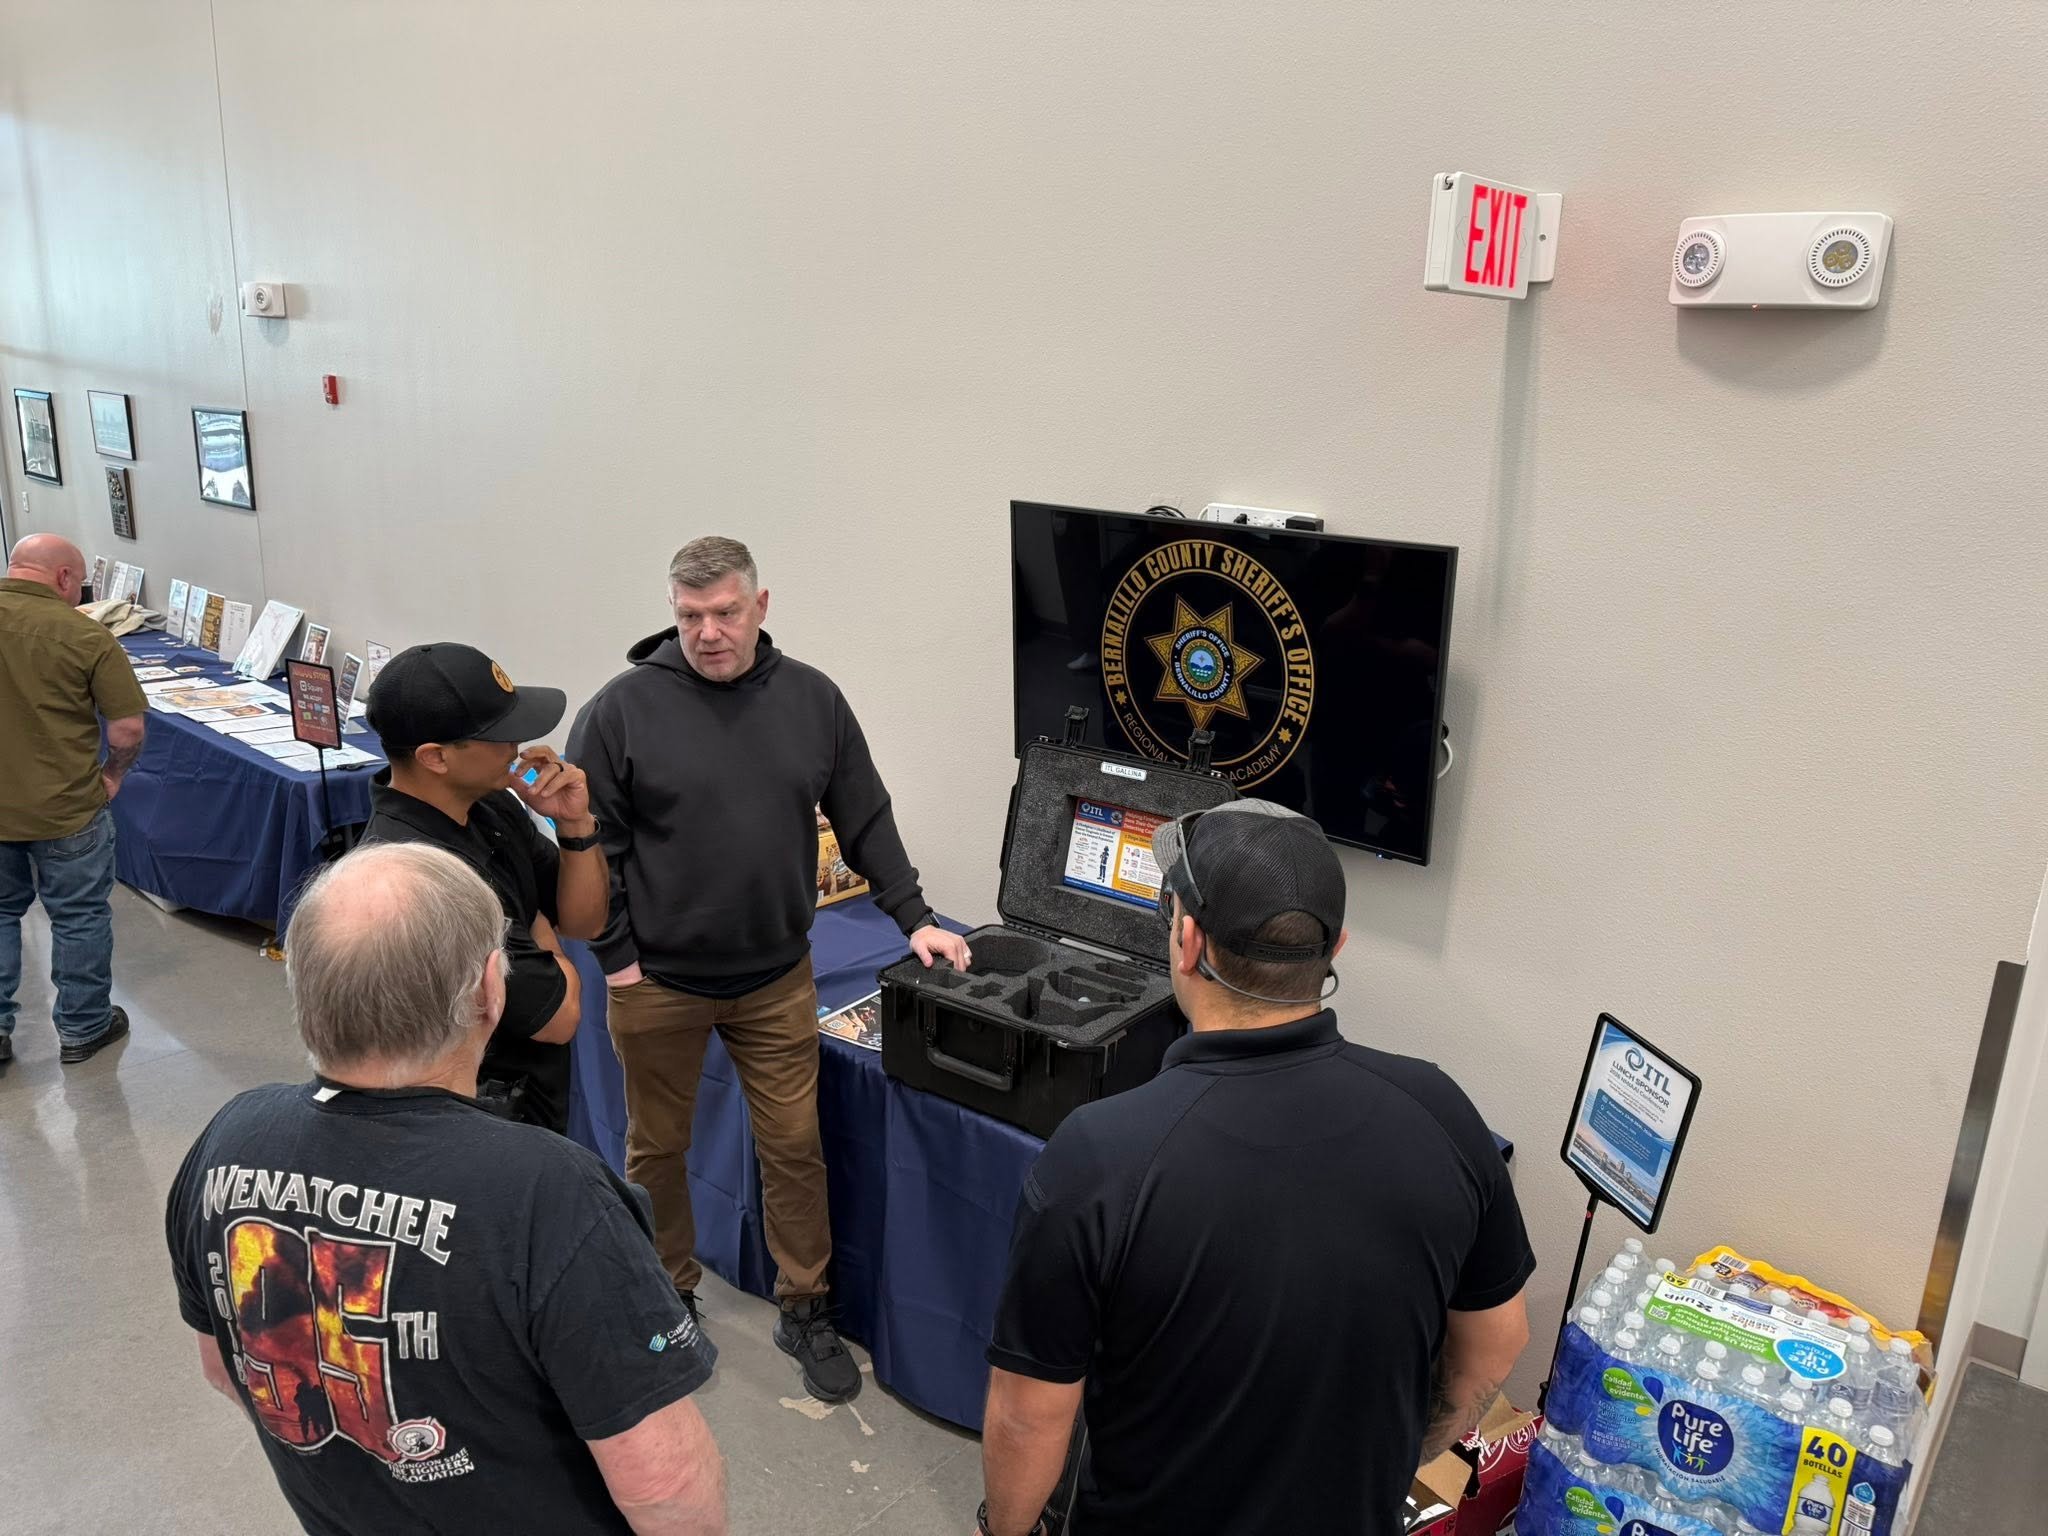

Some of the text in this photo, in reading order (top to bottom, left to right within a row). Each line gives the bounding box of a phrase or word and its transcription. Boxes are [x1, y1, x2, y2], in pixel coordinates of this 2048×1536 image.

[1464, 184, 1528, 289] EXIT
[1104, 543, 1312, 727] BERNALILLO COUNTY SHERIFF'S OFFICE
[1175, 629, 1230, 658] SHERIFF'S OFFICE
[1174, 661, 1231, 700] BERNALILLO COUNTY
[1123, 712, 1169, 764] REGIONAL
[1115, 766, 1142, 778] GALLINA
[1229, 743, 1283, 783] ACADEMY
[1090, 806, 1104, 817] ITL
[1612, 1060, 1635, 1082] LUNCH
[1635, 1078, 1670, 1108] SPONSOR
[1643, 1062, 1671, 1096] ITL
[203, 1164, 457, 1266] WENATCHEE
[391, 1310, 438, 1361] TH
[1788, 1354, 1830, 1375] Pure
[1795, 1350, 1827, 1367] Life
[1603, 1372, 1633, 1388] Calidad
[1609, 1387, 1645, 1401] evidente
[1671, 1402, 1724, 1438] Pure
[1673, 1423, 1714, 1454] Life
[1806, 1435, 1848, 1468] 40
[388, 1458, 442, 1471] HINGTON
[409, 1455, 469, 1475] FIGHTERS
[1655, 1447, 1726, 1484] HIDRATACIÓN SALUDABLE
[1803, 1458, 1843, 1479] BOTELLAS
[1565, 1491, 1595, 1507] Calidad
[1571, 1506, 1606, 1519] evidente
